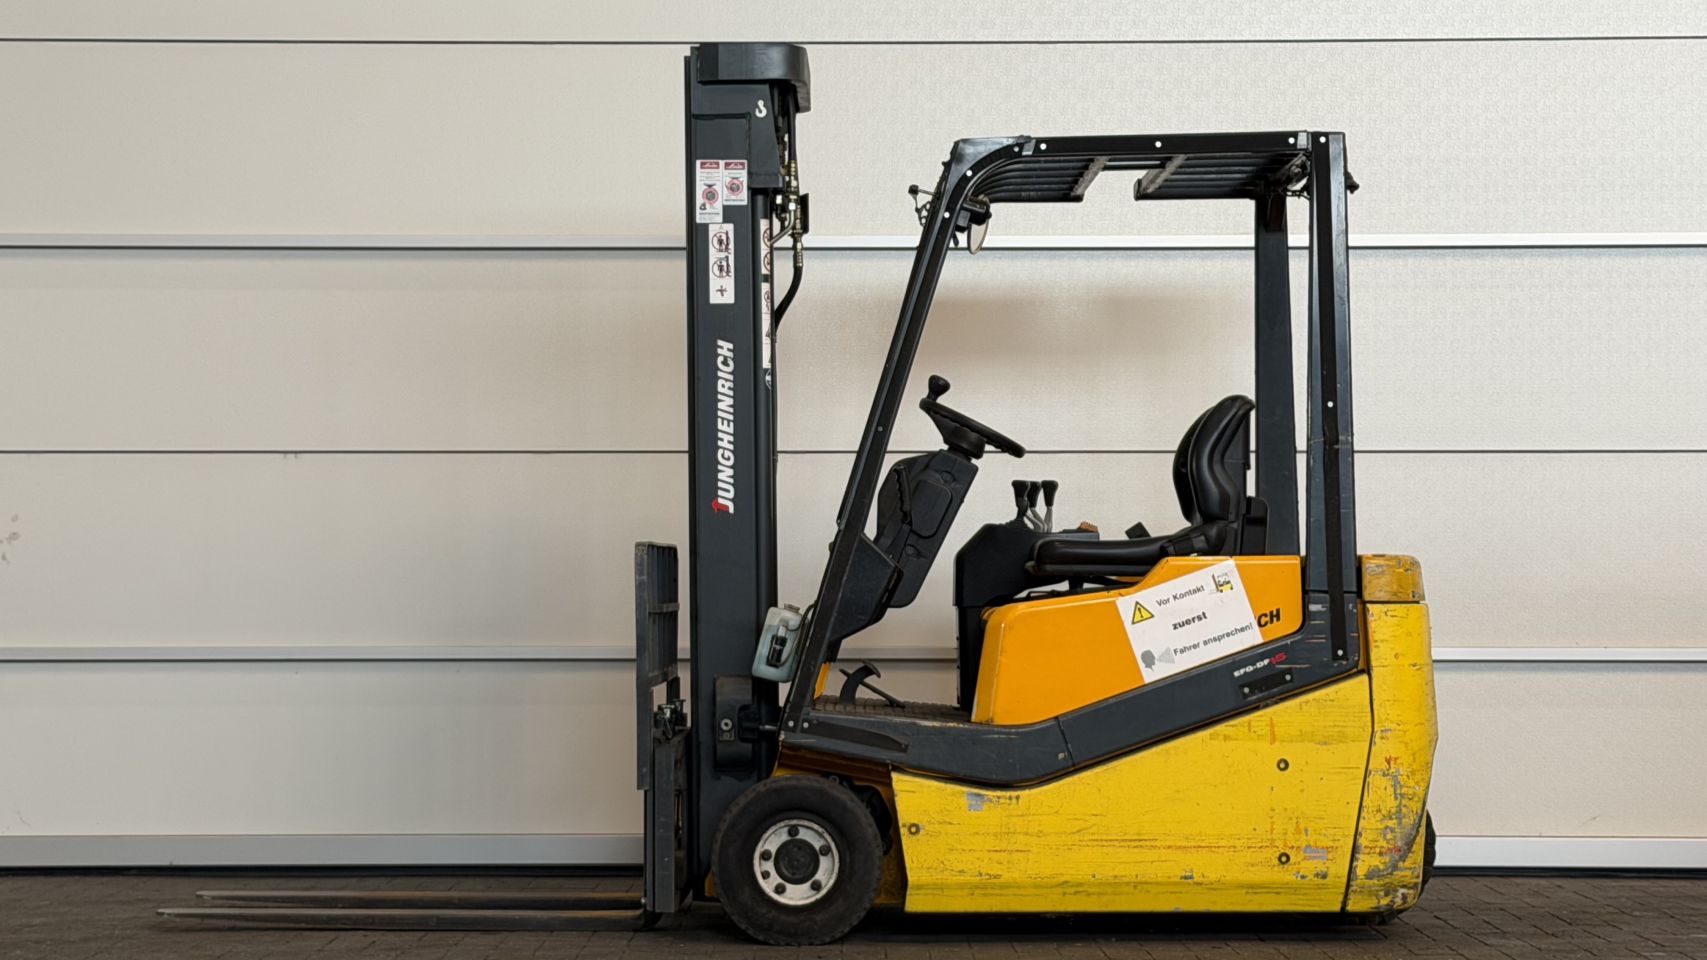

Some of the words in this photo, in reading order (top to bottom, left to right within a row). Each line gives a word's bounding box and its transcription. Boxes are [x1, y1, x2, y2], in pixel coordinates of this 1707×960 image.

[712, 339, 735, 514] JUNGHEINRICH
[1155, 597, 1170, 607] Vor
[1172, 584, 1205, 601] Kontakt
[1172, 611, 1207, 630] zuerst
[1173, 642, 1200, 656] Fahrer
[1203, 622, 1253, 647] ansprechen!
